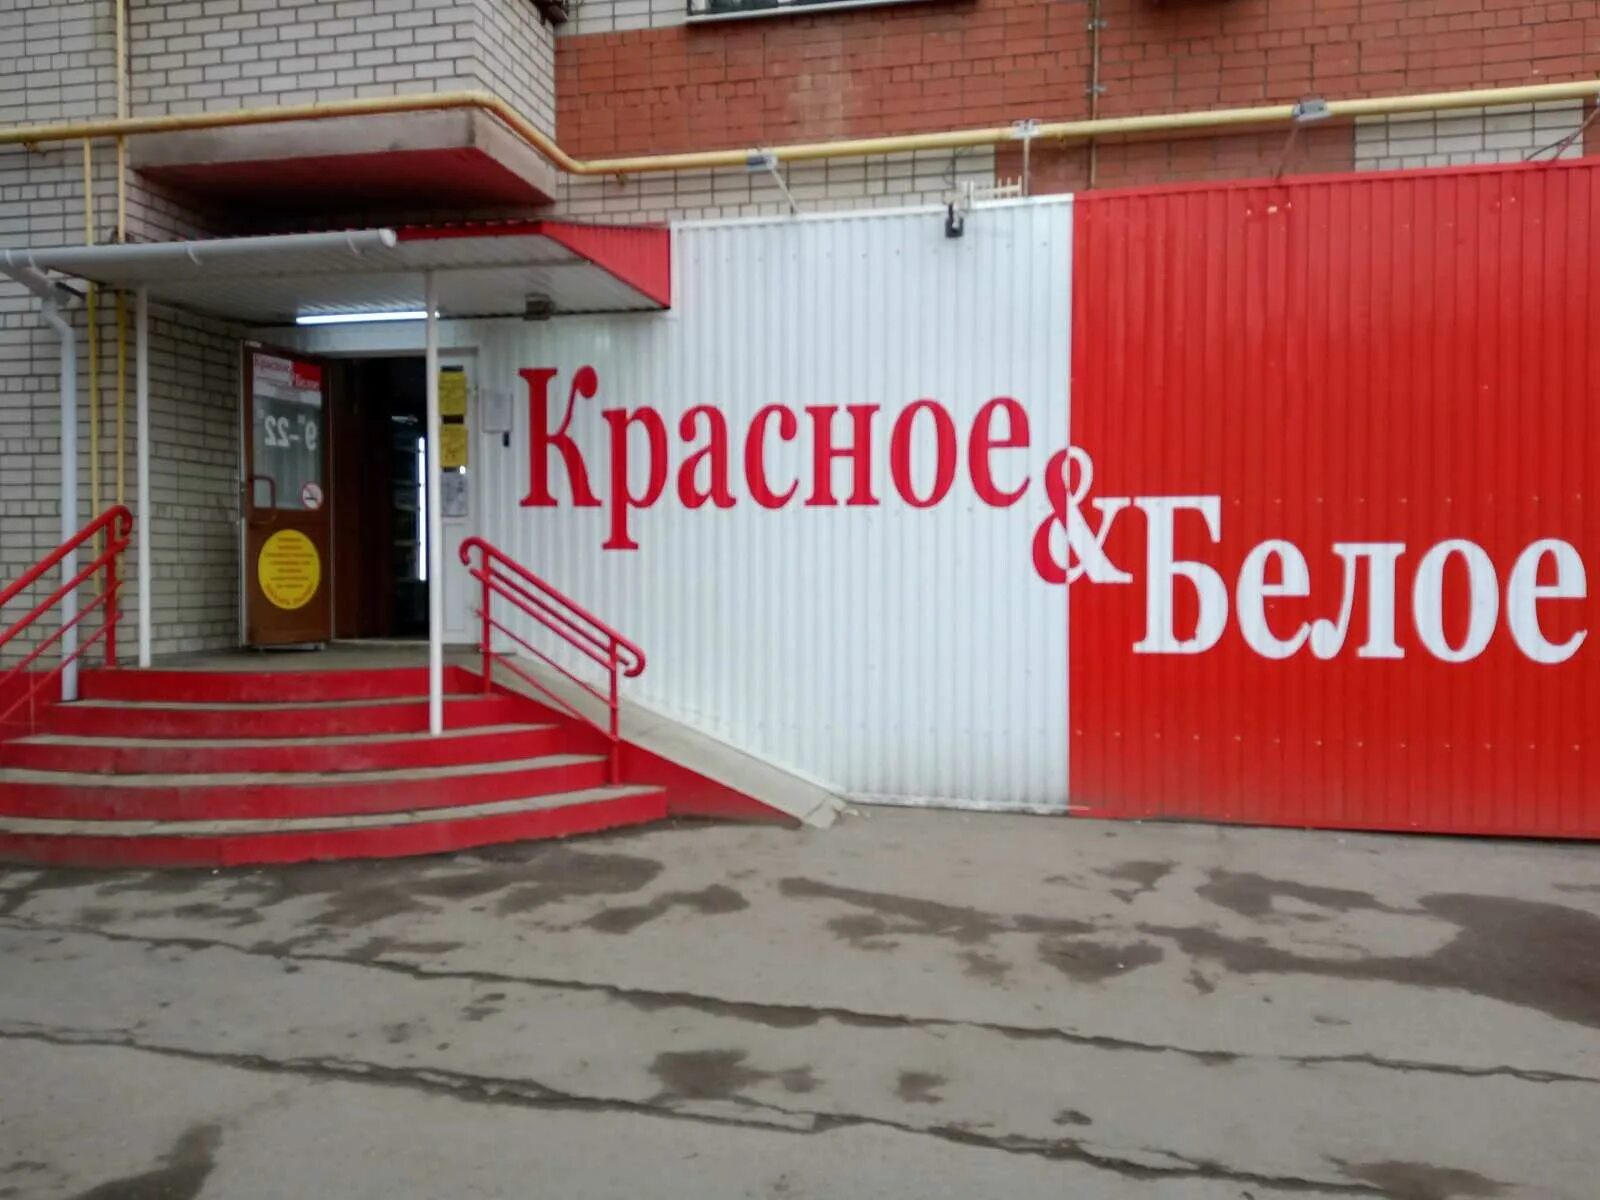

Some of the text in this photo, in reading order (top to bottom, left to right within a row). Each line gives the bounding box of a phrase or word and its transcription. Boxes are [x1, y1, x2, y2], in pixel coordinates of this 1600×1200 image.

[518, 366, 1030, 551] Красное
[1033, 446, 1133, 585] &
[1133, 495, 1588, 664] Белое
